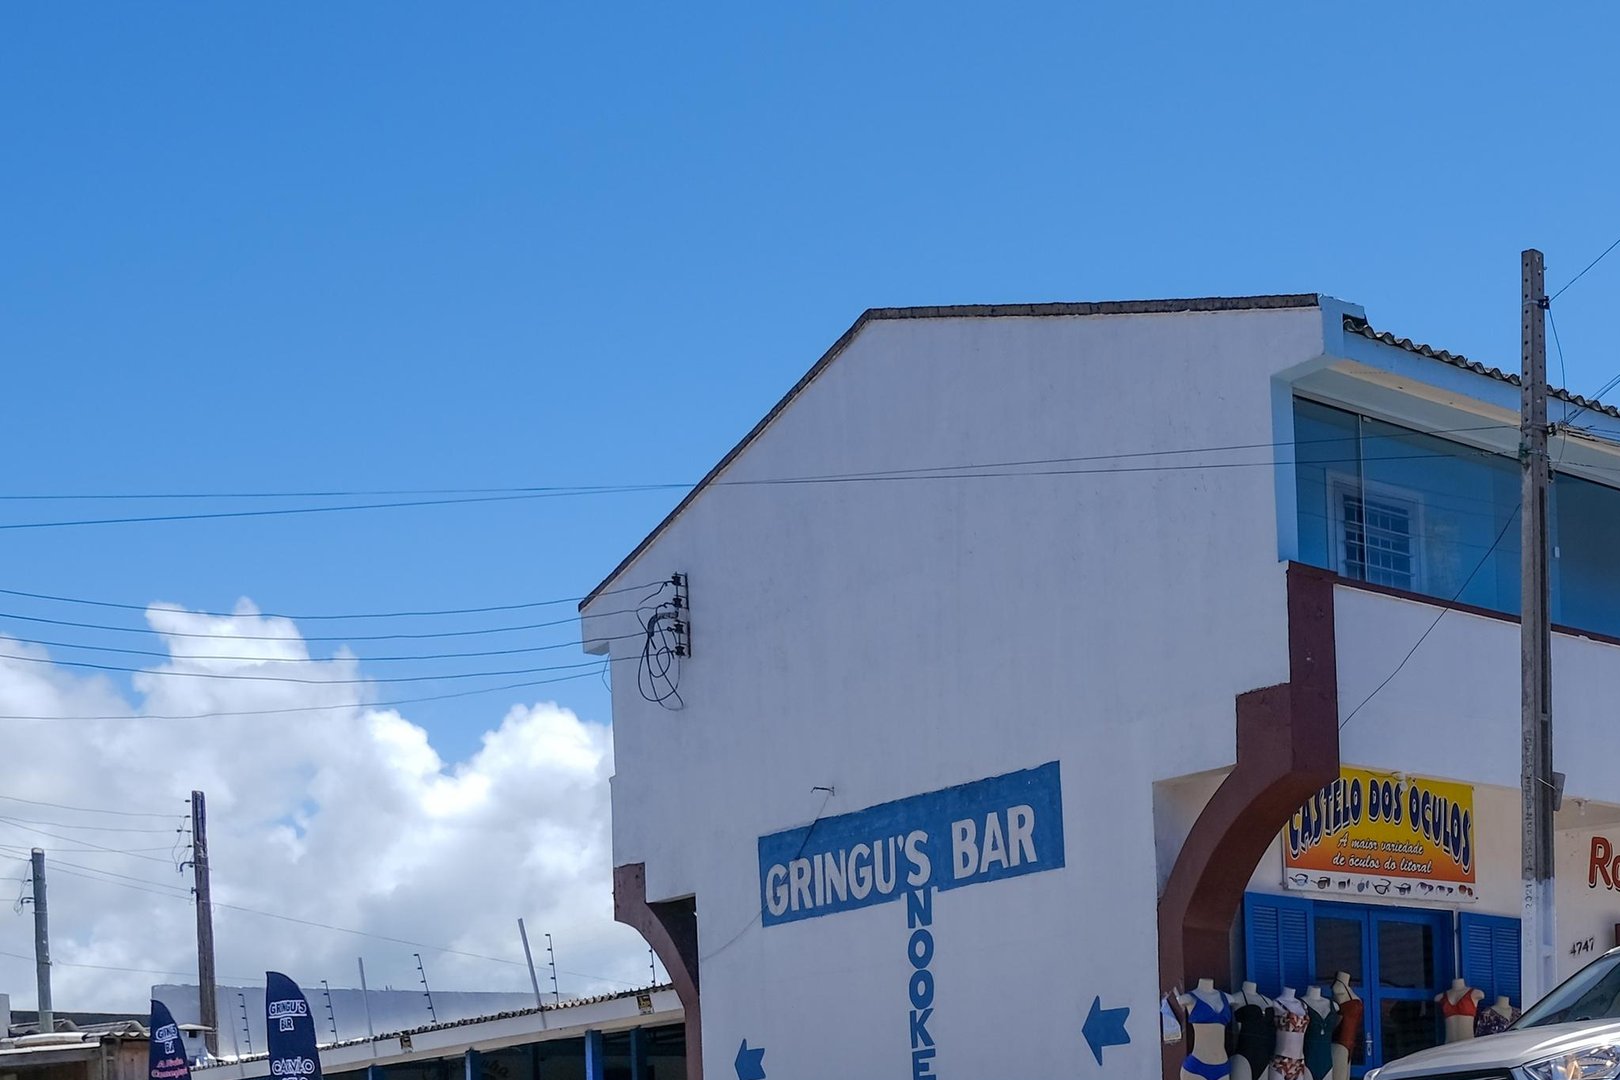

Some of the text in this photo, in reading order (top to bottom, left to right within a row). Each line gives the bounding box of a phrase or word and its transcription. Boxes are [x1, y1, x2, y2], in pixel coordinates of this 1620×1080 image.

[1369, 779, 1402, 827] DOS
[1337, 832, 1424, 855] A maior variedade
[765, 804, 1038, 917] GRINGU'S BAR
[1332, 853, 1433, 874] de óculos do litoral
[1570, 936, 1595, 957] 4747
